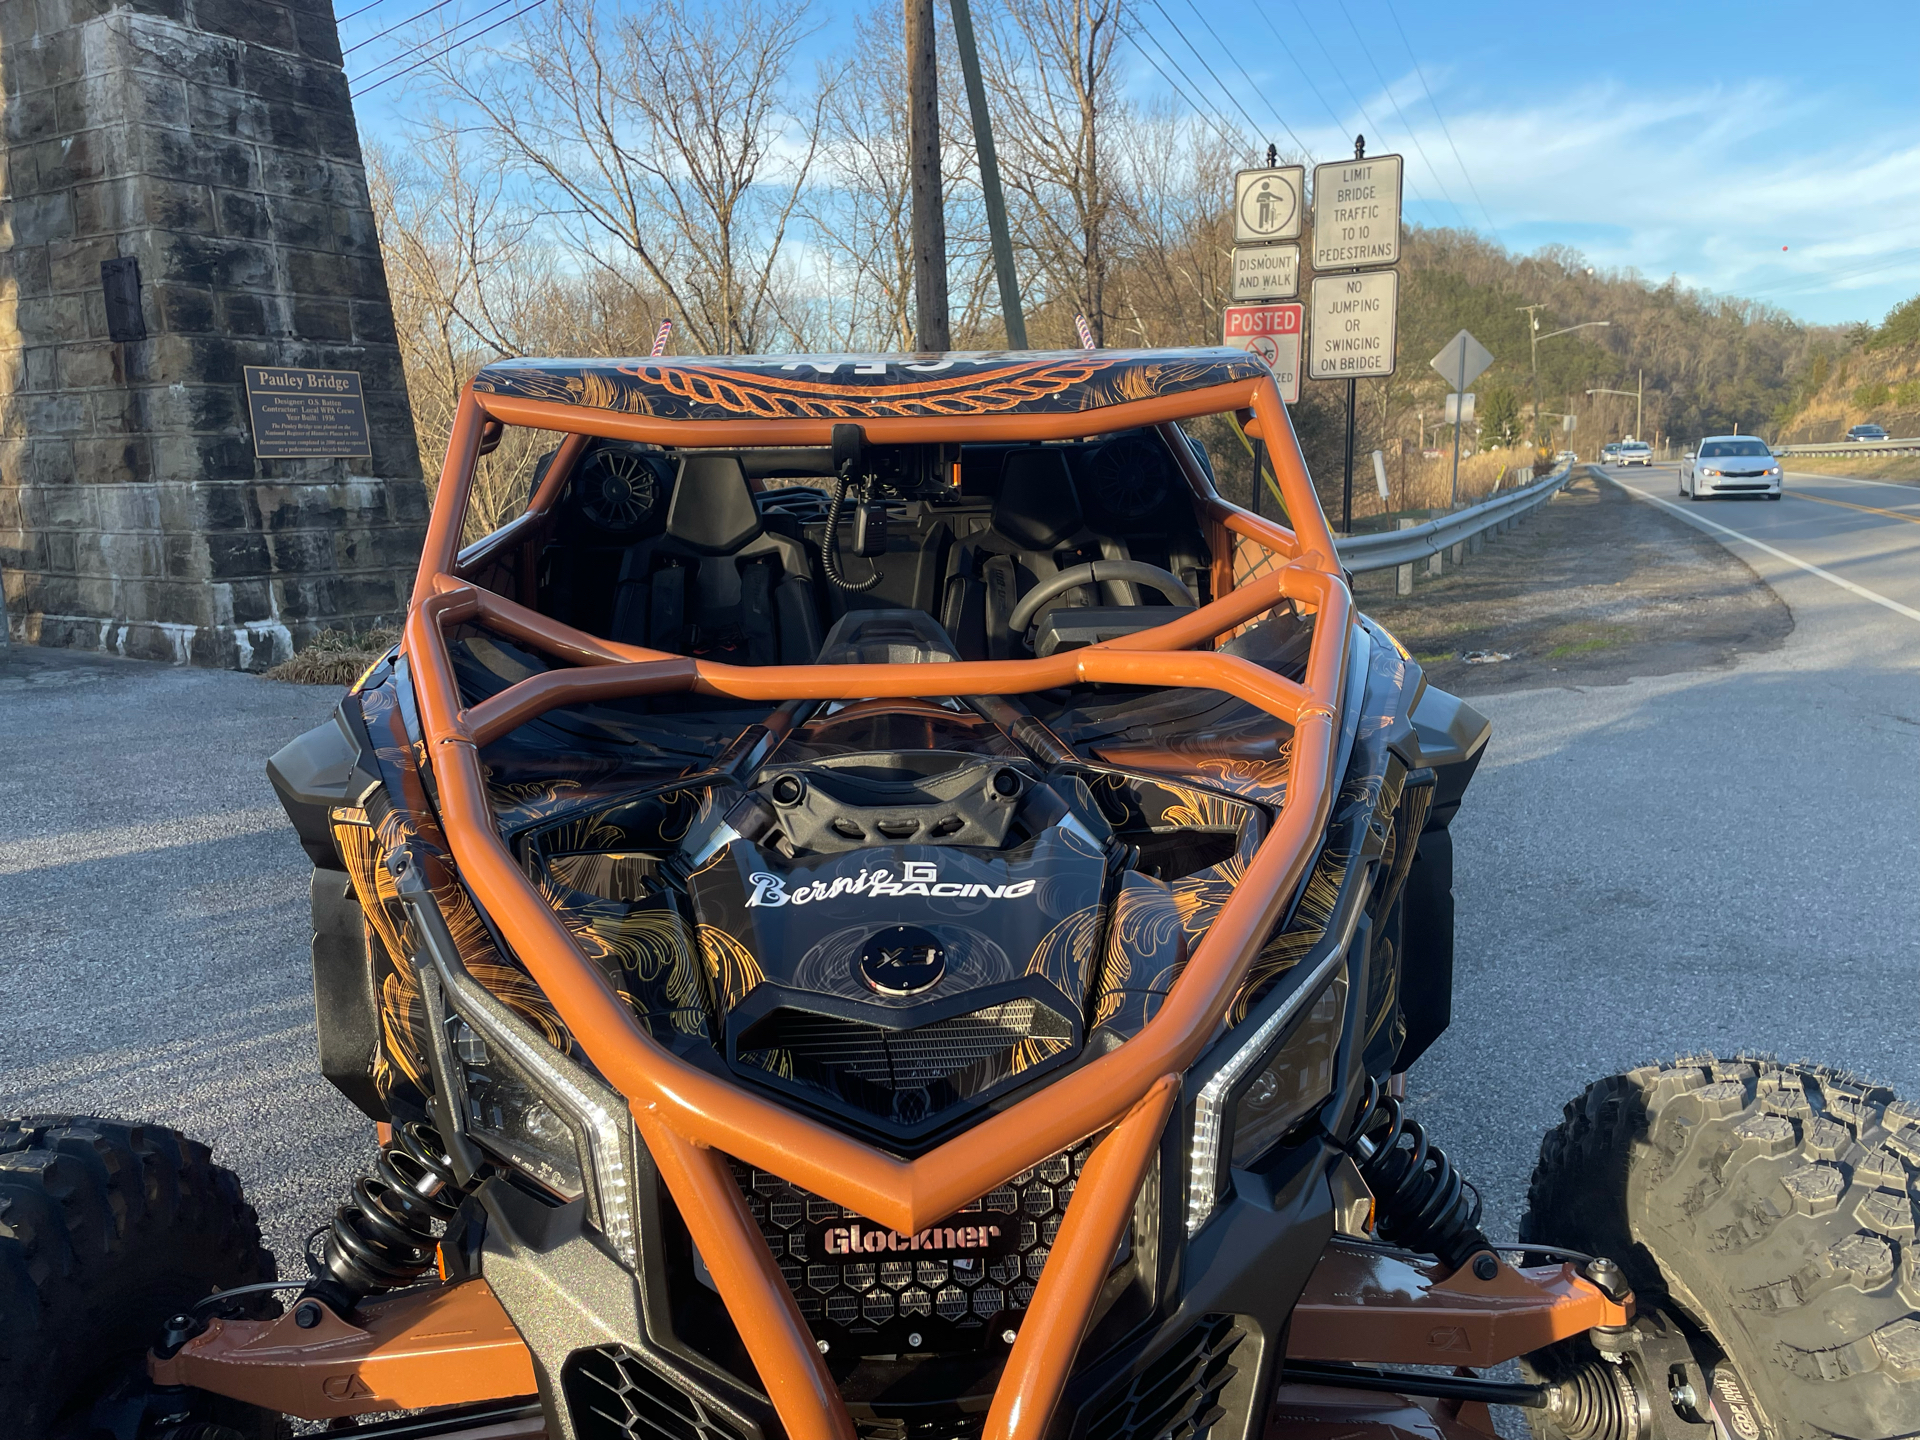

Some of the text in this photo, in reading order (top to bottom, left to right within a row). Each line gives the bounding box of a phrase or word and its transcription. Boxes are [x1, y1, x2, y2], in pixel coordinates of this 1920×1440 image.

[1343, 166, 1373, 182] LIMIT
[1337, 186, 1376, 203] BRIDGE
[1334, 205, 1379, 222] TRAFFIC
[1342, 225, 1370, 240] TO 10
[1318, 242, 1392, 262] PEDESTRIANS
[1239, 256, 1292, 271] DISMOUNT
[1239, 273, 1291, 289] AND WALK
[1346, 280, 1362, 294] NO
[1328, 298, 1380, 315] JUMPING
[1231, 310, 1296, 332] POSTED
[1345, 318, 1361, 332] OR
[1324, 336, 1380, 352] SWINGING
[1321, 355, 1382, 371] ON BRIDGE
[258, 371, 350, 392] Pauley Bridge
[262, 405, 298, 413] Contractor:
[320, 406, 336, 414] WPA
[274, 397, 342, 406] Designer: O.S. Batten
[286, 413, 301, 421] Year
[745, 868, 894, 907] Bernie
[868, 879, 1036, 898] RACING
